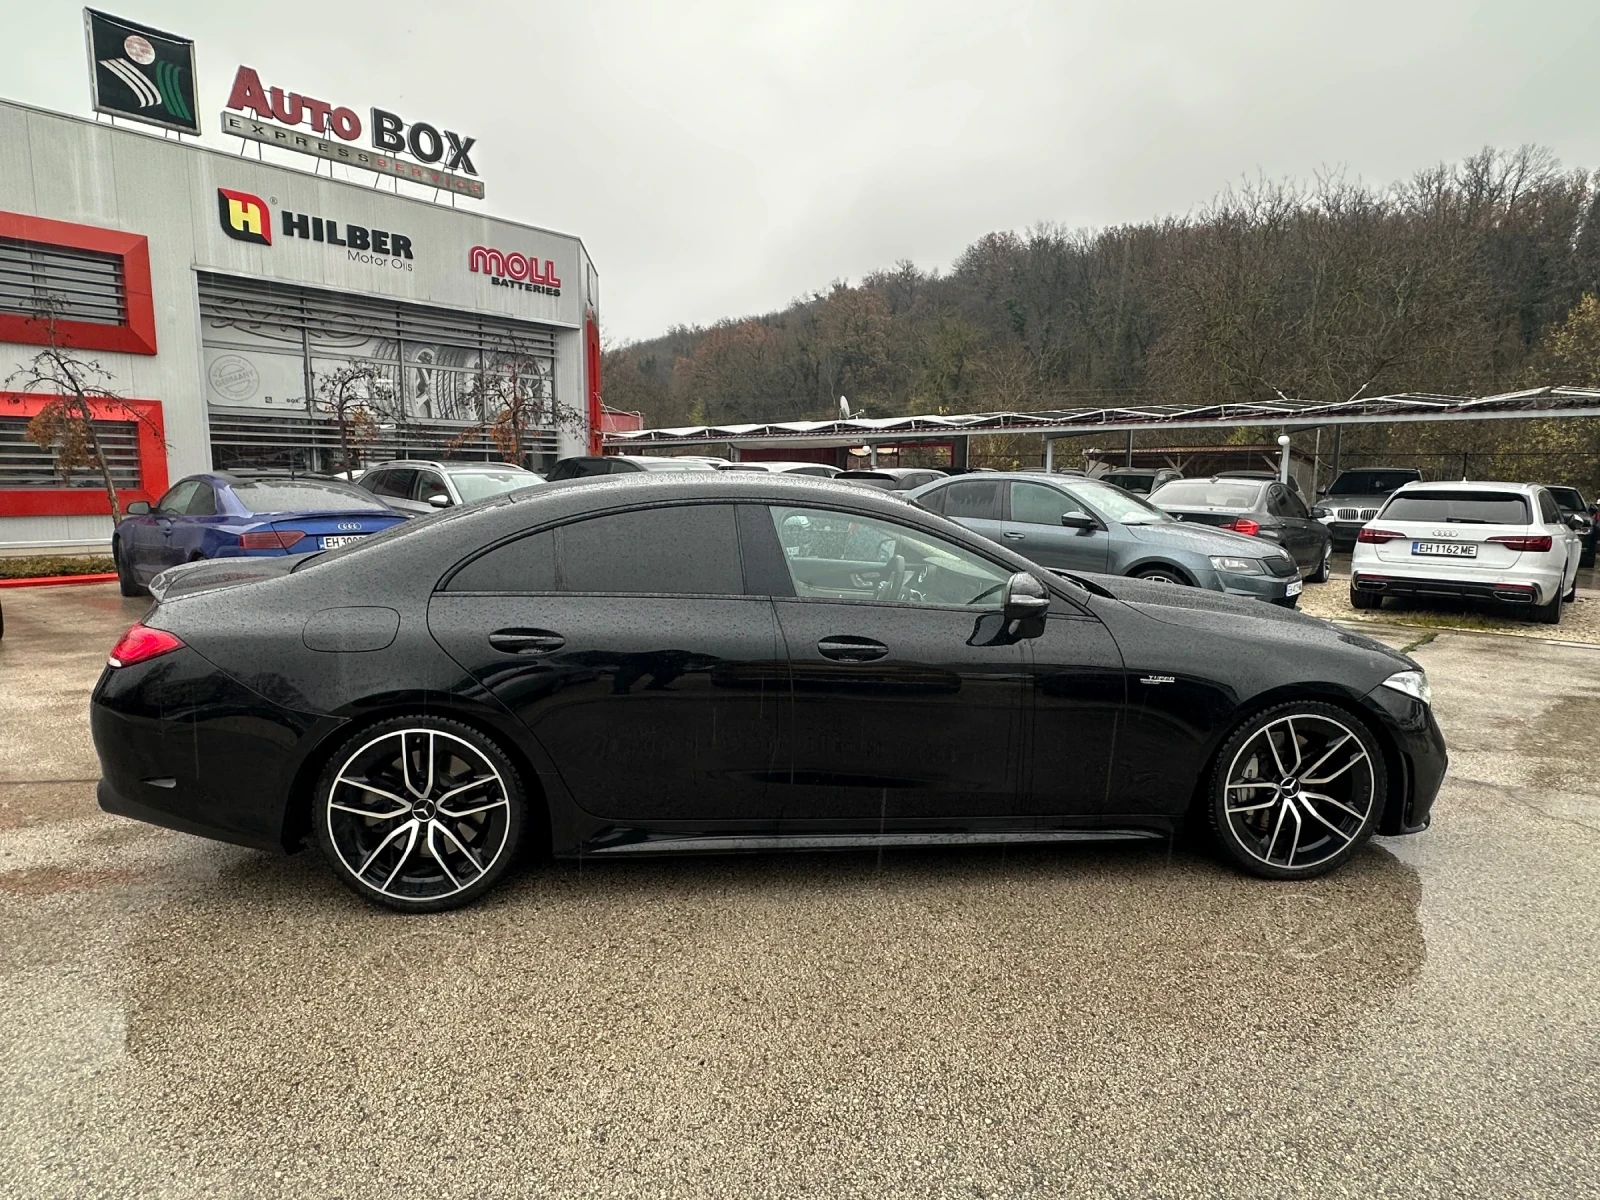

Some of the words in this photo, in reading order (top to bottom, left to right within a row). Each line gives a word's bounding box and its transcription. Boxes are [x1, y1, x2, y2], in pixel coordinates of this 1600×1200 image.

[226, 65, 362, 141] AUTO
[370, 107, 479, 175] BOX
[229, 118, 369, 164] EXPRESS
[376, 158, 482, 194] SERVICE
[282, 210, 414, 260] HILBER
[347, 249, 388, 268] Motor
[391, 258, 413, 272] Oils
[469, 245, 562, 288] MOLL
[490, 276, 562, 297] BATTERIES
[214, 370, 255, 388] GERMANY
[325, 537, 340, 548] EH
[1419, 543, 1433, 553] EH
[1435, 544, 1459, 555] 1162
[1460, 545, 1475, 555] ME
